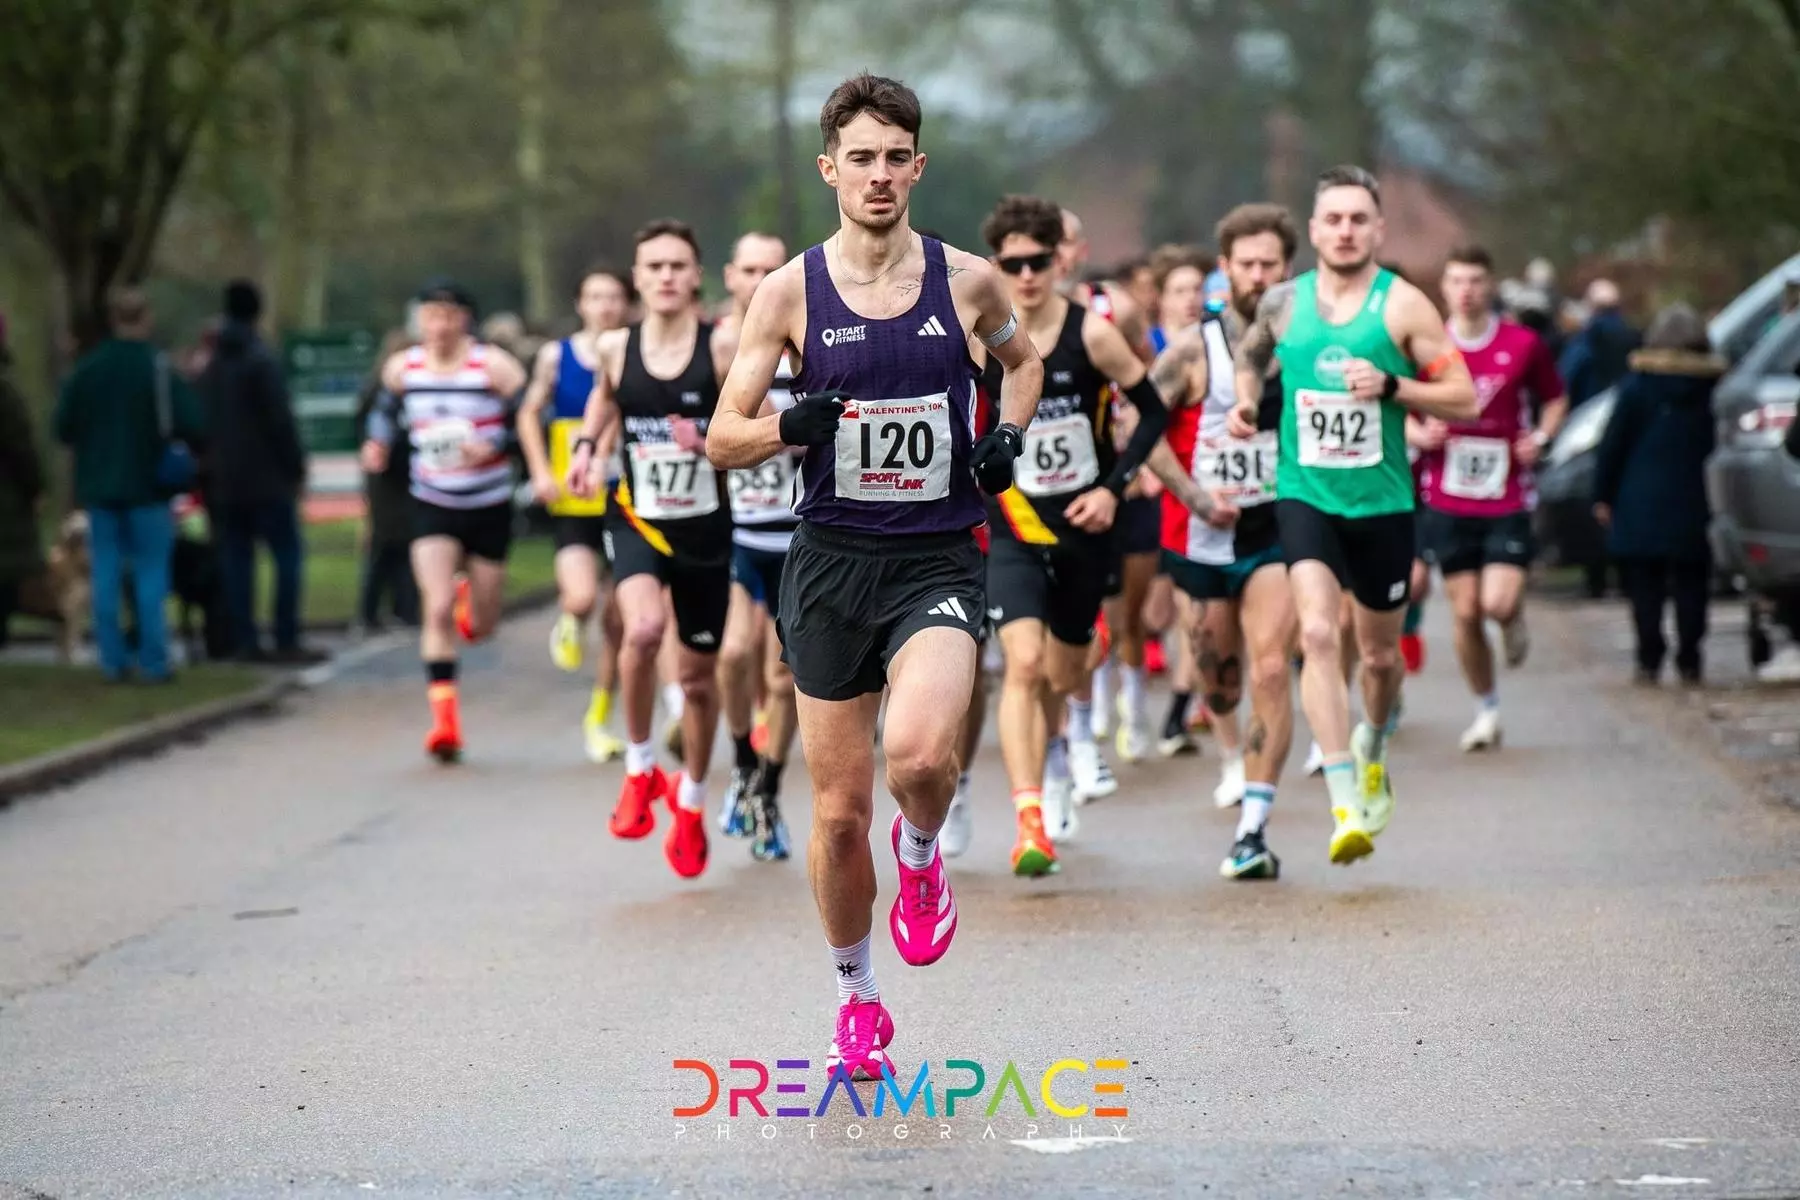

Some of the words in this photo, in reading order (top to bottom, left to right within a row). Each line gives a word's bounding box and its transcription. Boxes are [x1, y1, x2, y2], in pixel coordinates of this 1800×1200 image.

[835, 324, 867, 338] START
[835, 333, 866, 344] FITNESS
[863, 404, 926, 415] VALENTINE'S
[928, 402, 943, 412] 10K
[1310, 410, 1367, 444] 942
[860, 420, 934, 469] 120
[1035, 434, 1072, 471] 65
[647, 460, 698, 493] 477
[860, 472, 903, 483] SPORT
[1213, 449, 1263, 484] 431
[894, 479, 927, 490] LINK
